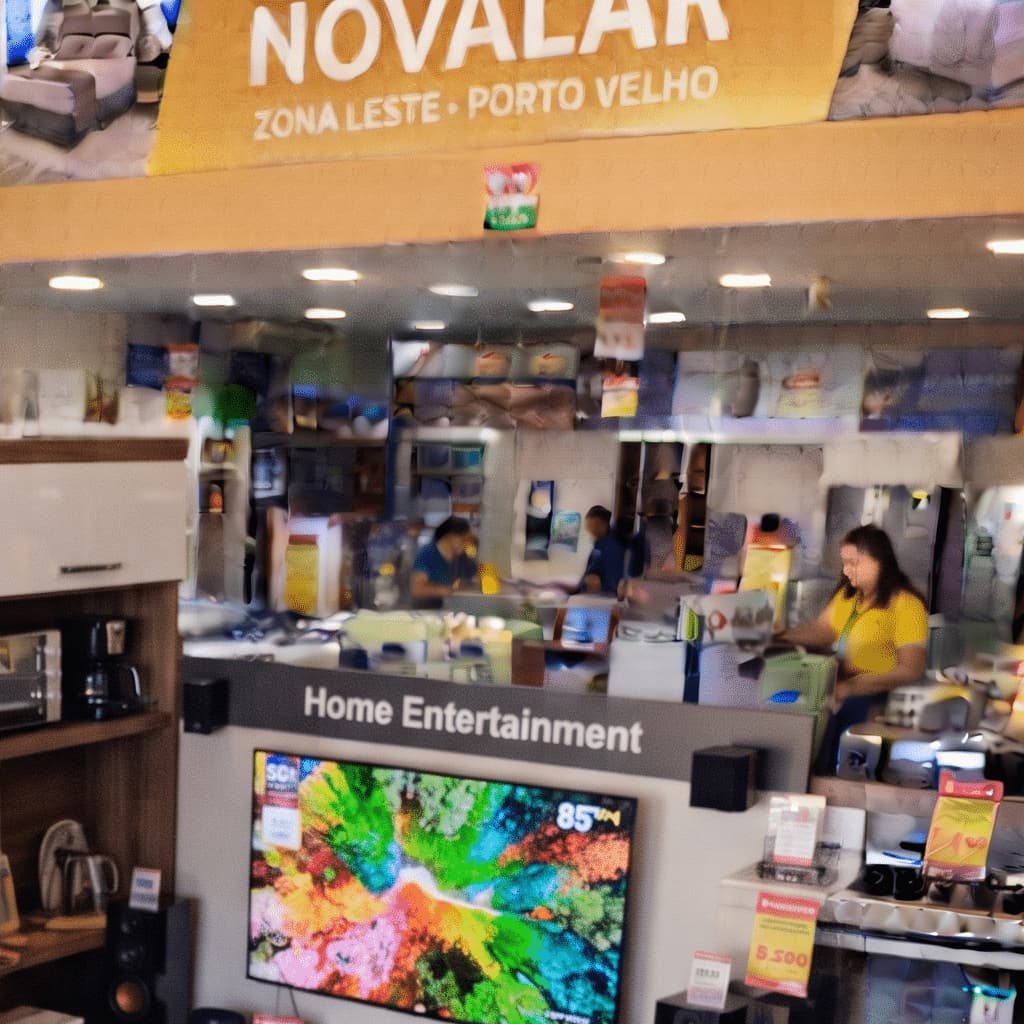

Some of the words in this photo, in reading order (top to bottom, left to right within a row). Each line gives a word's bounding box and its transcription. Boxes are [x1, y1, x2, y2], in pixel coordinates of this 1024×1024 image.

[254, 101, 338, 141] ZONA
[346, 91, 442, 132] LESTE
[468, 77, 584, 119] PORTO
[595, 65, 719, 108] VELHO
[304, 686, 393, 725] Home
[401, 695, 644, 754] Entertainment
